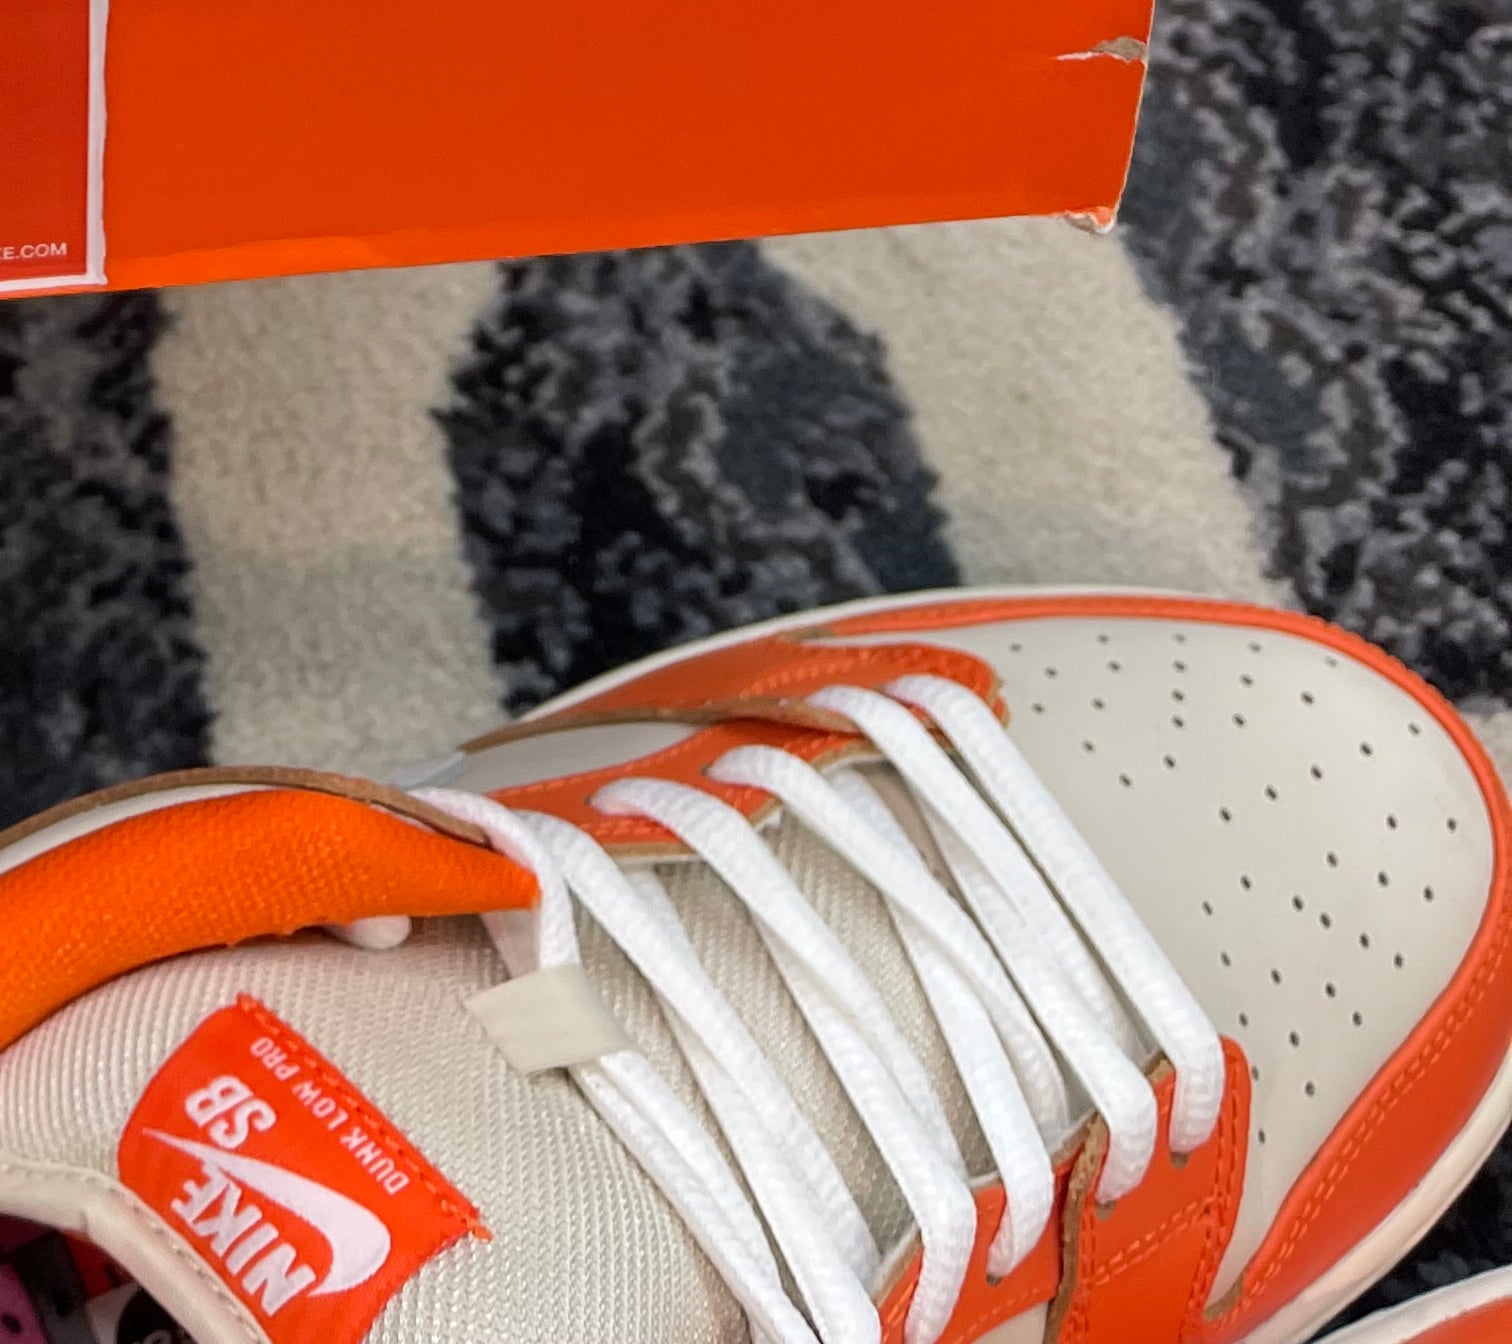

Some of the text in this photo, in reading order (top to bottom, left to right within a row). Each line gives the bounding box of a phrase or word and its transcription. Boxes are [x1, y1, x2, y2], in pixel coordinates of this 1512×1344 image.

[170, 1074, 316, 1318] NIKE SB
[250, 1036, 410, 1196] DUNK LOW PRO
